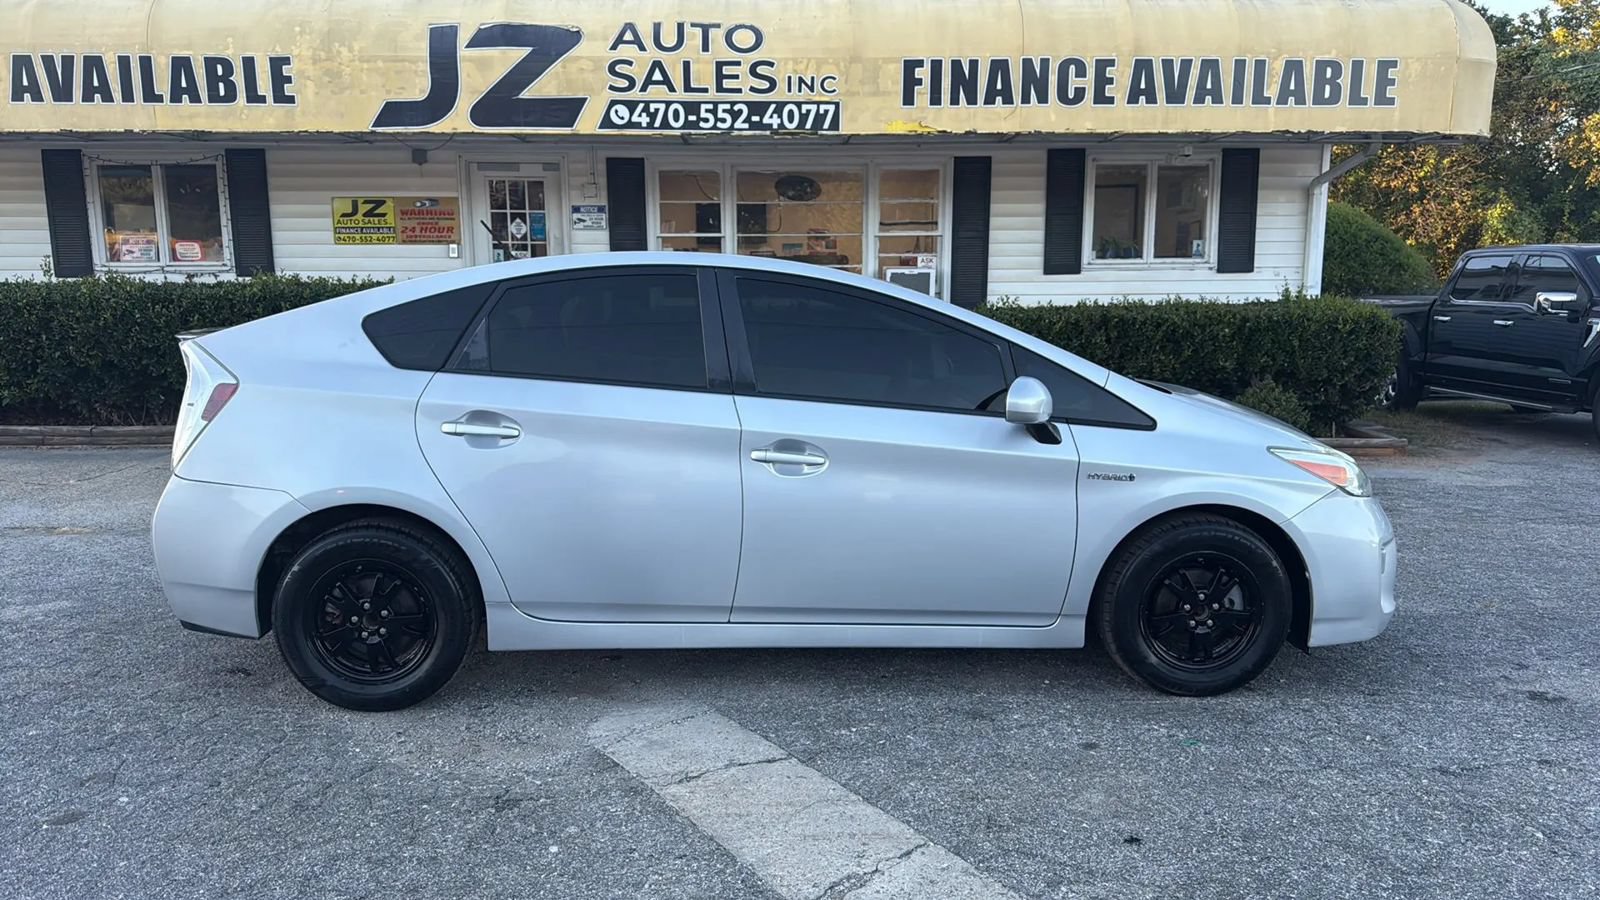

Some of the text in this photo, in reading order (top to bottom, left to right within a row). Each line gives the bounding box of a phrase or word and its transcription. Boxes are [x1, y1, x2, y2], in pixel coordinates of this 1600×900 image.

[607, 21, 765, 54] AUTO
[10, 53, 297, 106] AVAILABLE
[370, 22, 590, 130] JZ
[606, 58, 839, 95] SALES INC
[901, 56, 1399, 108] FINANCE AVAILABLE
[630, 104, 836, 130] 470-552-4077
[339, 199, 389, 218] JZ
[336, 218, 360, 226] AUTO
[361, 218, 388, 226] SALES
[400, 225, 455, 234] 24 HOUR
[341, 235, 396, 243] 470-552-4077
[1087, 473, 1128, 481] HYBRID
